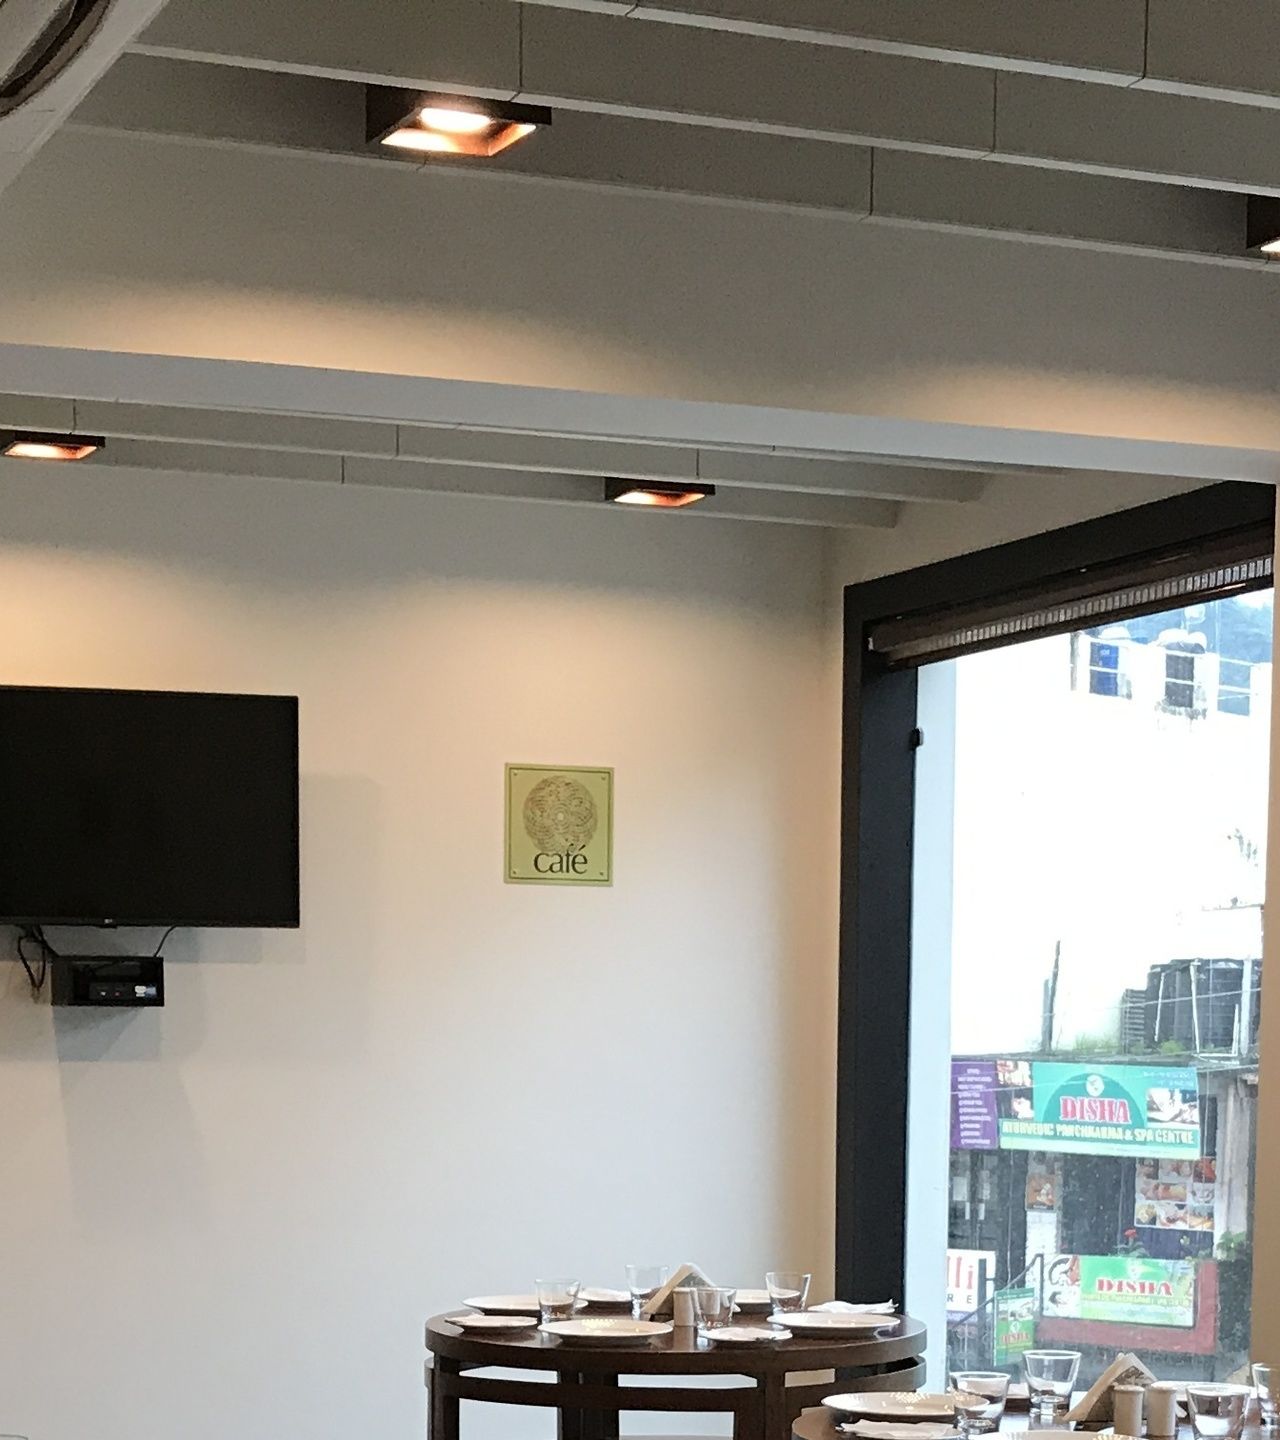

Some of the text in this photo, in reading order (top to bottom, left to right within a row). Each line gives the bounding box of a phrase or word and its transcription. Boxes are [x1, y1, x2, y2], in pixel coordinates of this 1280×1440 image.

[533, 843, 588, 874] café
[1060, 1096, 1131, 1124] DISHA
[1134, 1128, 1154, 1142] SPA
[1155, 1129, 1195, 1145] CENTRE
[1096, 1278, 1173, 1296] DISHA
